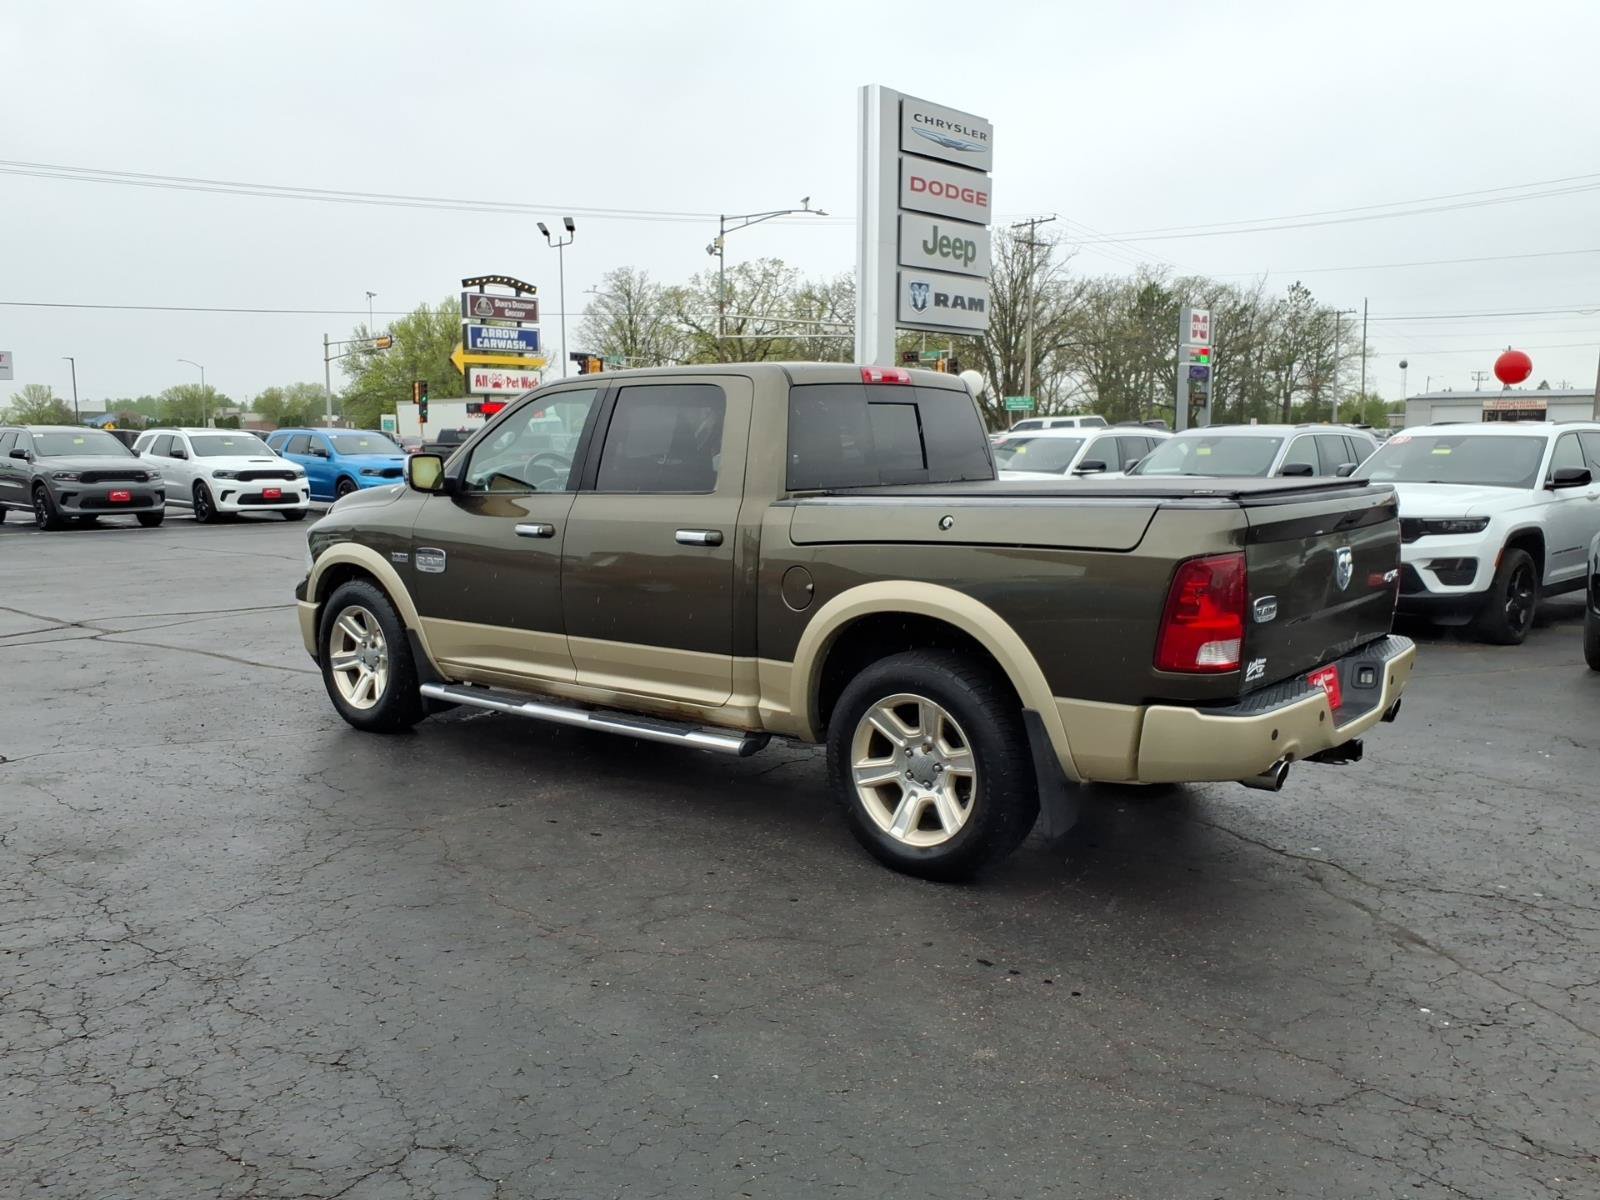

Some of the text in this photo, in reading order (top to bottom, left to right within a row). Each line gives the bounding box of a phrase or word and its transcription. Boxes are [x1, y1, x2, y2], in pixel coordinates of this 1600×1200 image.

[913, 113, 987, 141] CHRYSLER
[910, 176, 987, 207] DODGE
[922, 225, 977, 268] Jeep
[934, 292, 985, 313] RAM
[476, 338, 526, 350] CARWASH
[481, 328, 519, 339] ARROW
[475, 374, 488, 387] All
[506, 376, 520, 388] Pet
